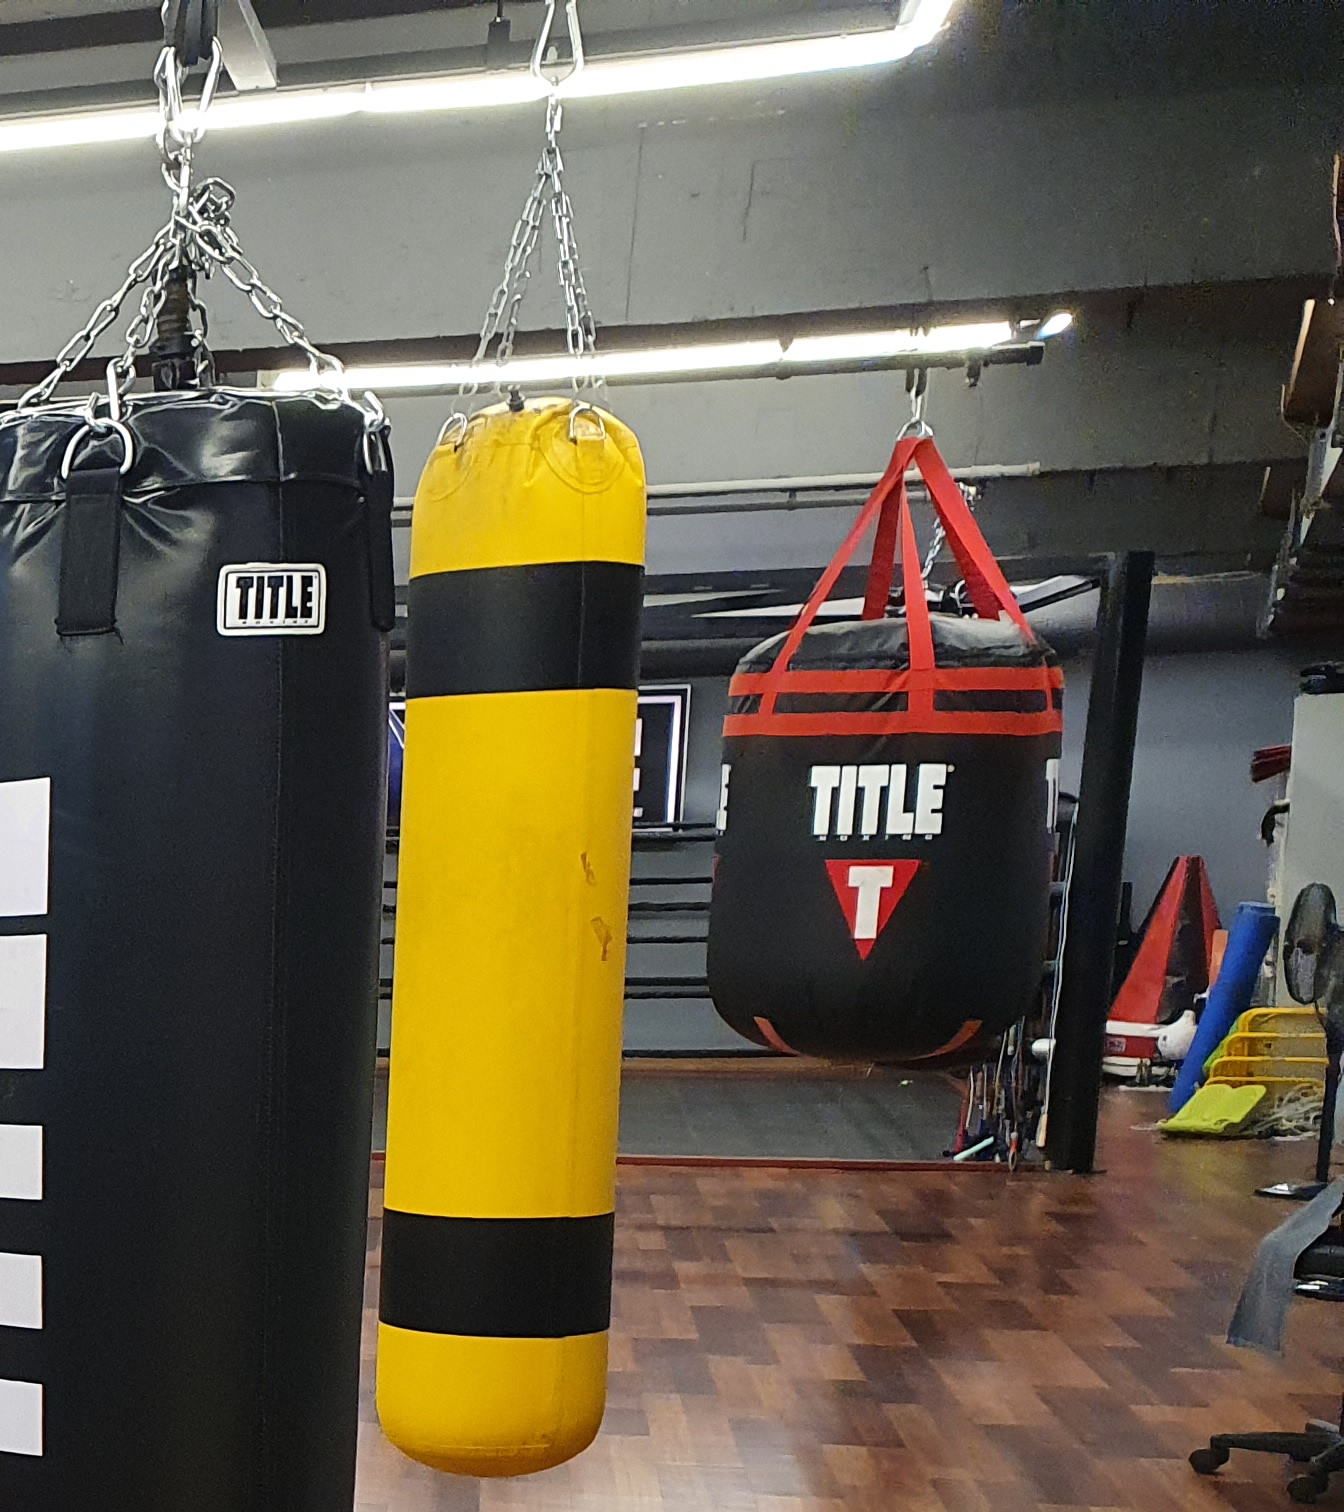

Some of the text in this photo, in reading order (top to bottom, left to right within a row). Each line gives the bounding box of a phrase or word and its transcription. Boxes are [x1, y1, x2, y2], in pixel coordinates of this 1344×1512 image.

[236, 575, 313, 619] TITLE
[809, 763, 948, 836] TITLE
[847, 865, 894, 939] T
